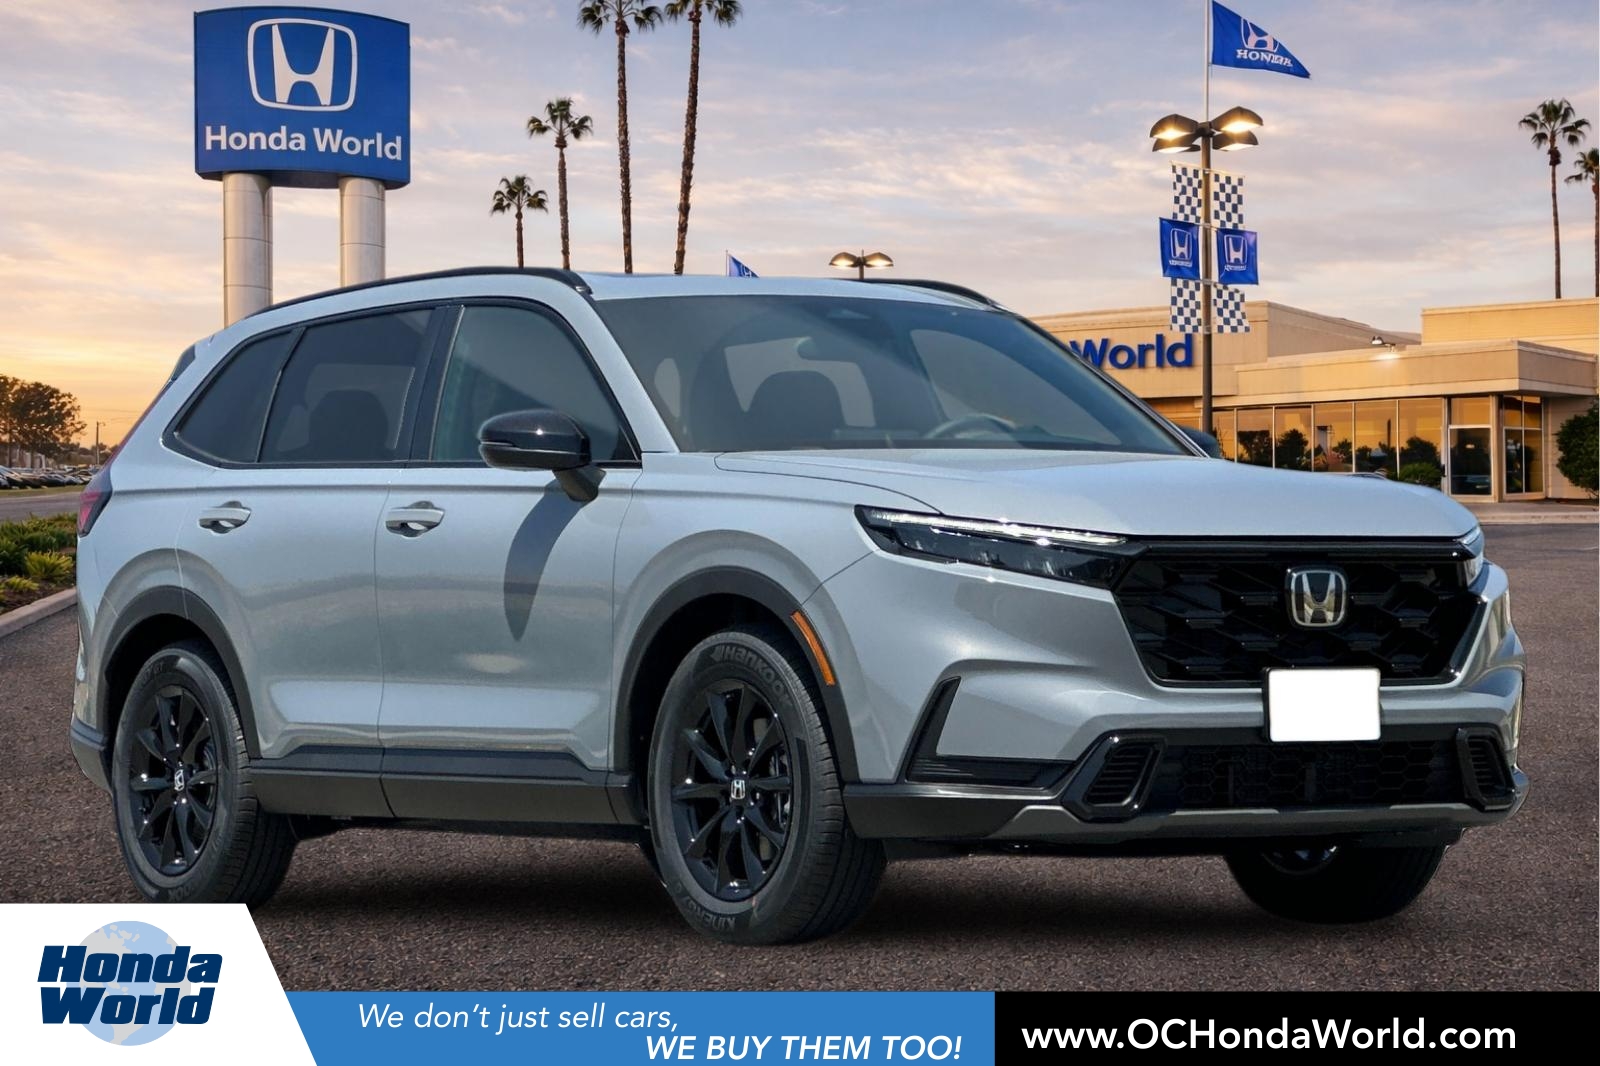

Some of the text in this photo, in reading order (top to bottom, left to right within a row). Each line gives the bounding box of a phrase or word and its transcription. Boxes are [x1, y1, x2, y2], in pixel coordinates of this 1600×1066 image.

[205, 125, 402, 161] Honda World
[1069, 332, 1194, 370] World
